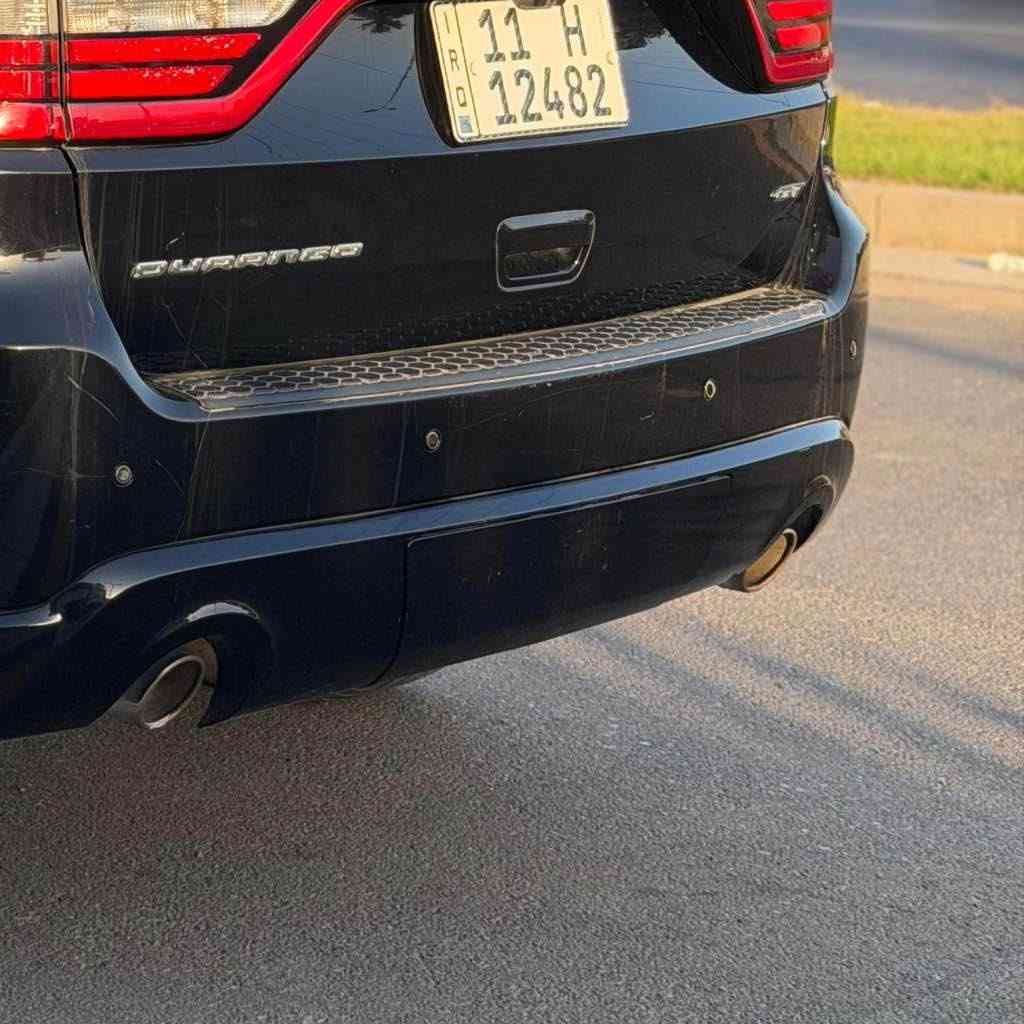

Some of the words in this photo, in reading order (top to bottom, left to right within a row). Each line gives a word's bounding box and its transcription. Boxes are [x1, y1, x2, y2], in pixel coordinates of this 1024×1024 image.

[478, 7, 531, 63] 11
[560, 4, 588, 58] H
[488, 63, 612, 125] 12482
[131, 242, 364, 278] DURANGO
